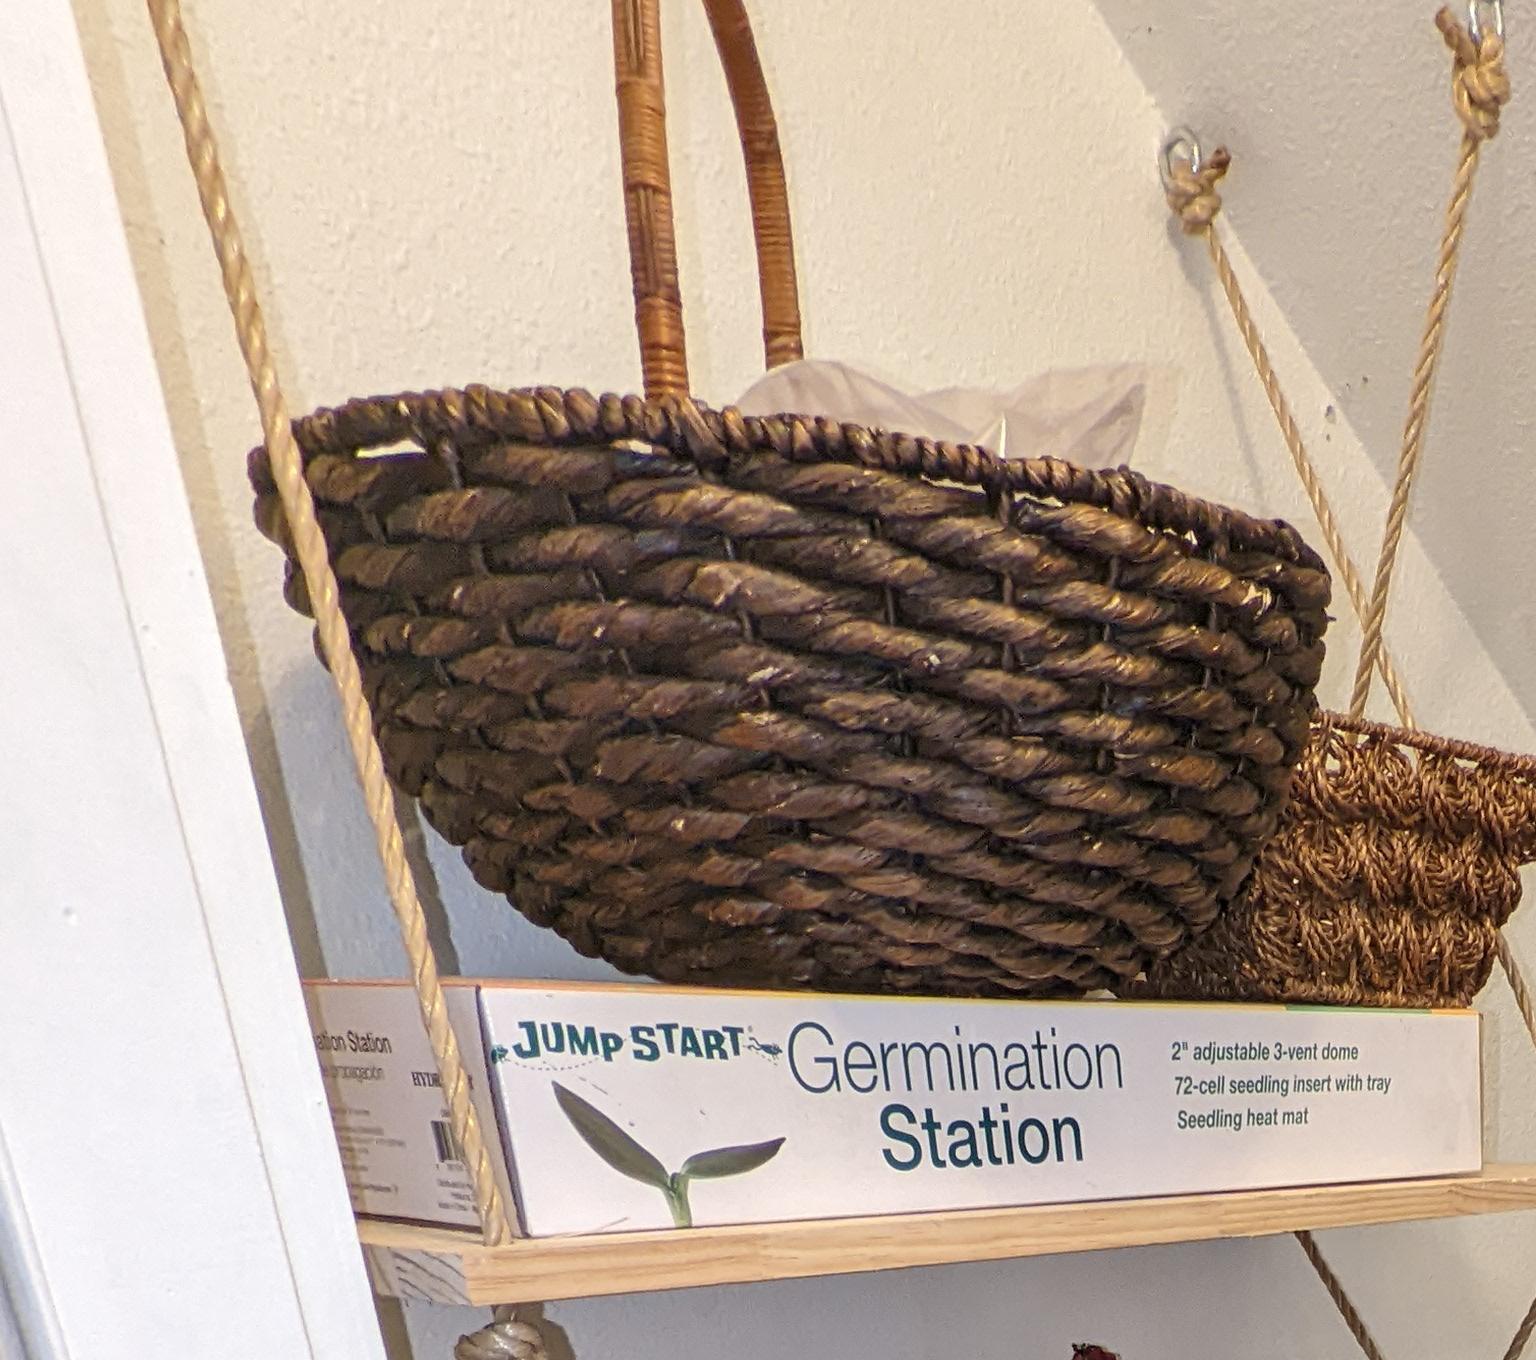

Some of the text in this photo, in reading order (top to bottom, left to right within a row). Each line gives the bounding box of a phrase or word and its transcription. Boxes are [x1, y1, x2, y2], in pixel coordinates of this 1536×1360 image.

[347, 1030, 392, 1054] Station
[512, 1020, 744, 1063] JUMP START
[1193, 1040, 1270, 1065] adjustable
[1273, 1043, 1319, 1061] 3-vent
[1321, 1041, 1359, 1061] dome
[787, 1021, 1124, 1094] Germination
[1174, 1073, 1392, 1099] 72-cell seedling insert with tray
[1177, 1107, 1309, 1131] Seedling heat mat
[880, 1102, 1083, 1172] Station
